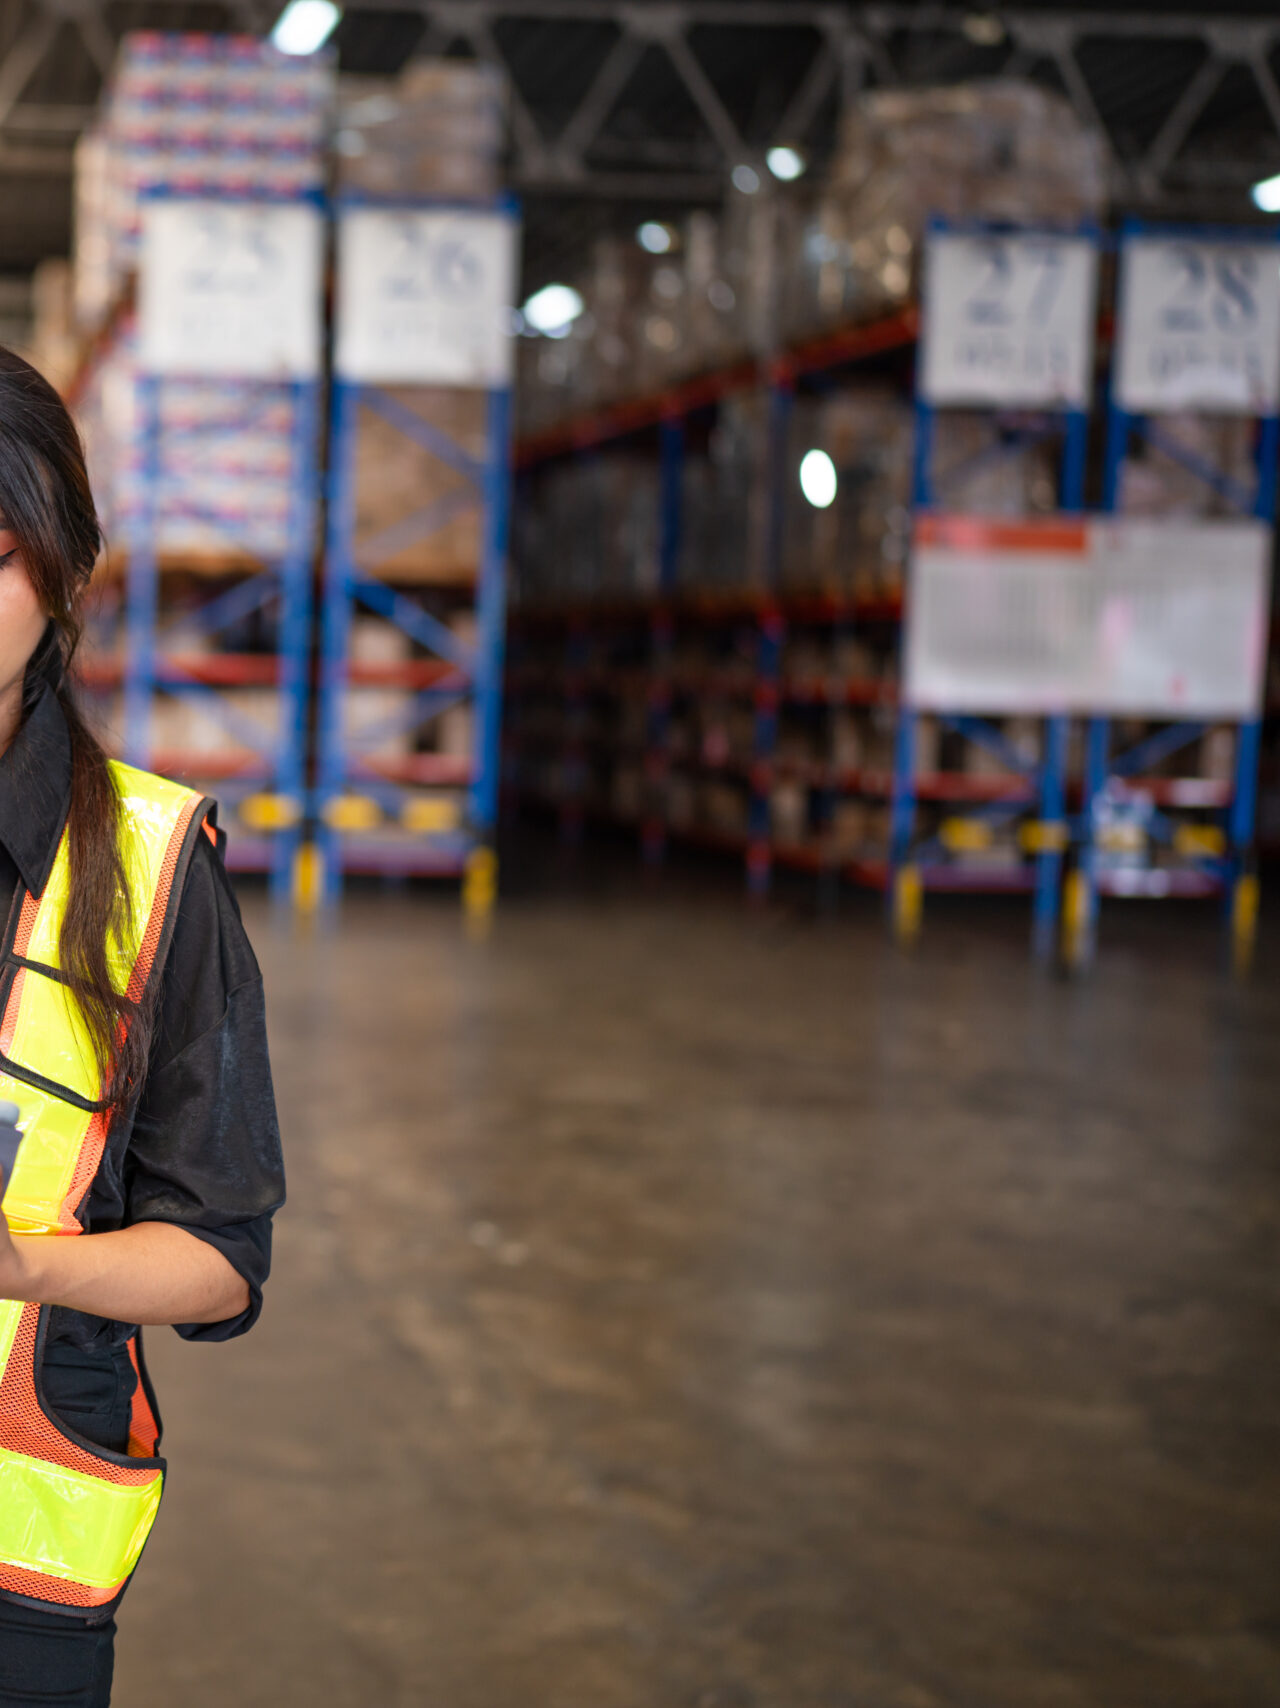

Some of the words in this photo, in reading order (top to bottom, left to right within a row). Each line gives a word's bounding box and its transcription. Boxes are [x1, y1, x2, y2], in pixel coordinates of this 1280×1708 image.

[377, 214, 485, 306] 26
[965, 236, 1067, 331] 27
[1156, 242, 1260, 337] 28
